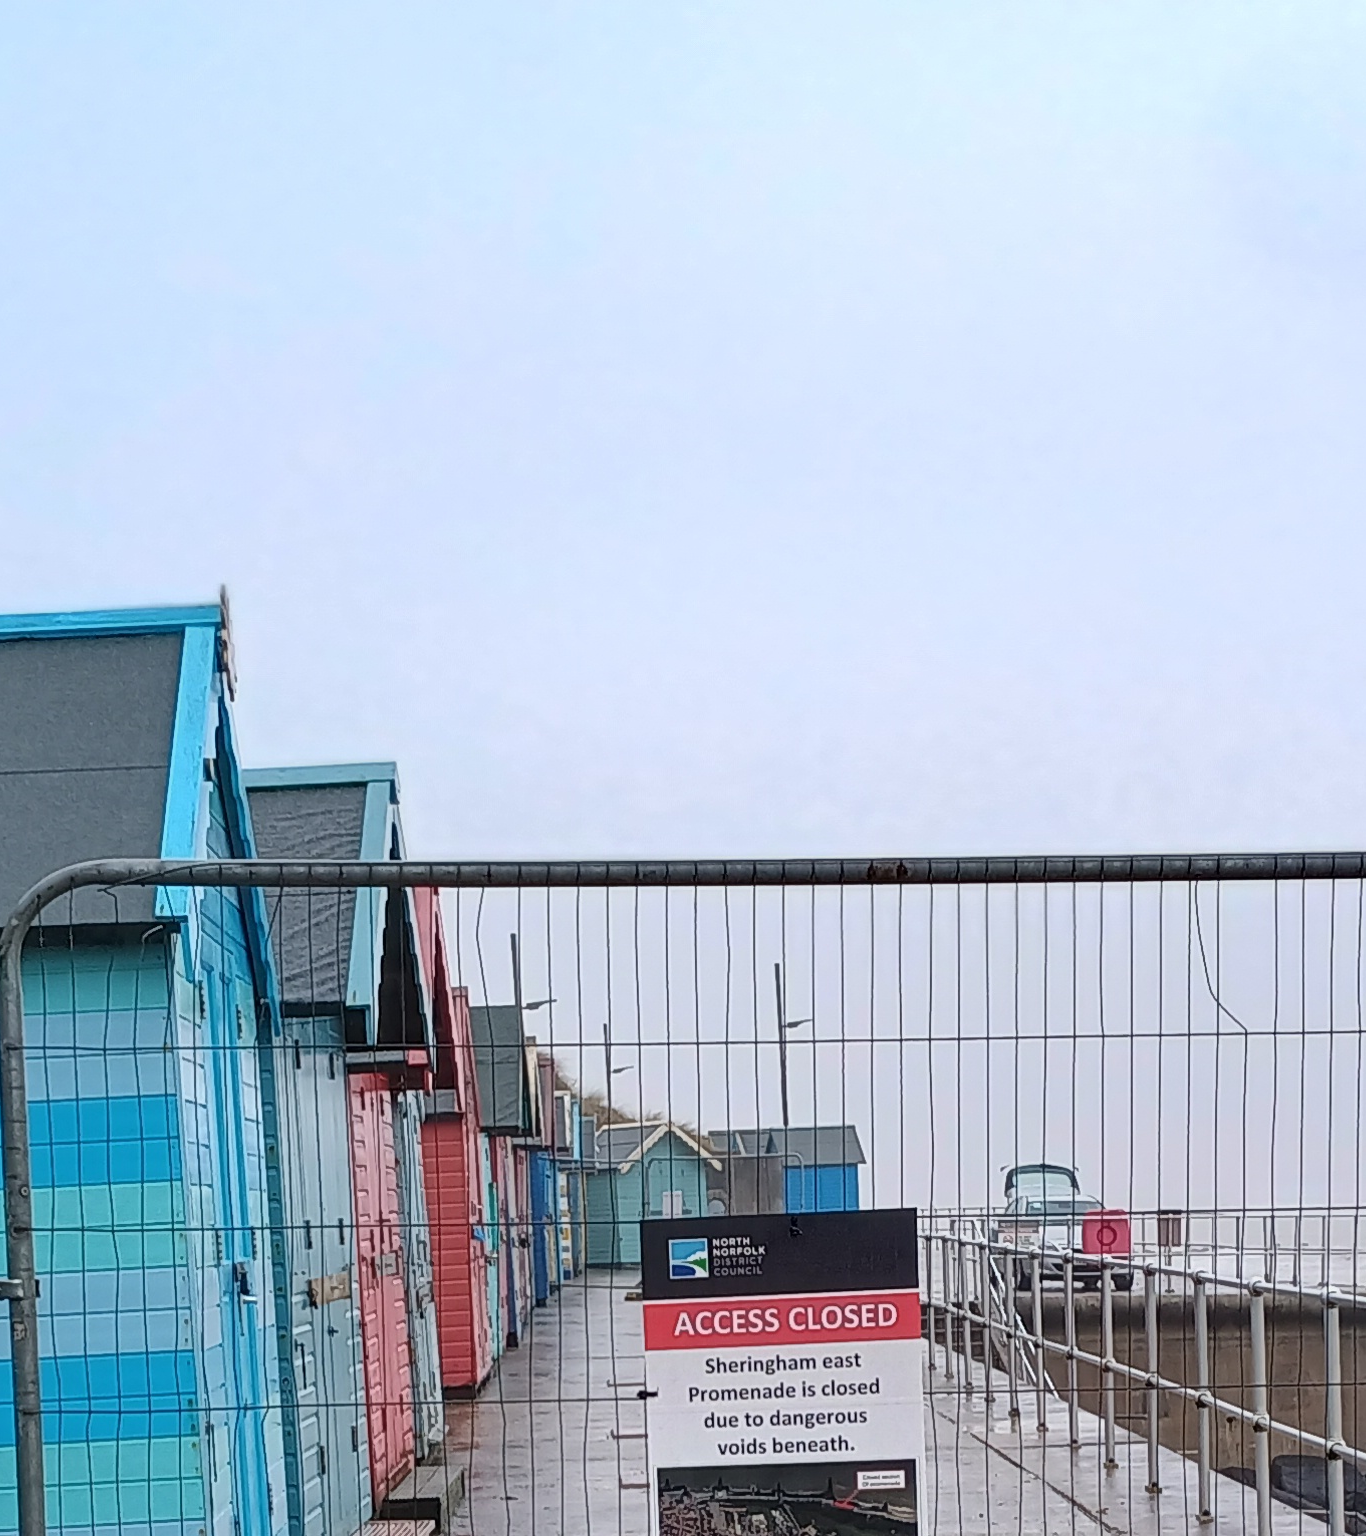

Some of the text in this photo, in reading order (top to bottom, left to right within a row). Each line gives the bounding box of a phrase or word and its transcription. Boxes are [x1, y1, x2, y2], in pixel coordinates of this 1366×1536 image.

[712, 1237, 750, 1247] NORTH
[712, 1245, 766, 1257] NORFOLK
[713, 1256, 763, 1267] DISTRICT
[713, 1265, 763, 1276] COUNCIL
[674, 1303, 898, 1336] ACCESS CLOSED
[705, 1352, 862, 1375] Sheringham east
[688, 1377, 880, 1403] Promenade is closed
[704, 1409, 868, 1429] due to dangerous
[717, 1434, 855, 1455] voids beneath.
